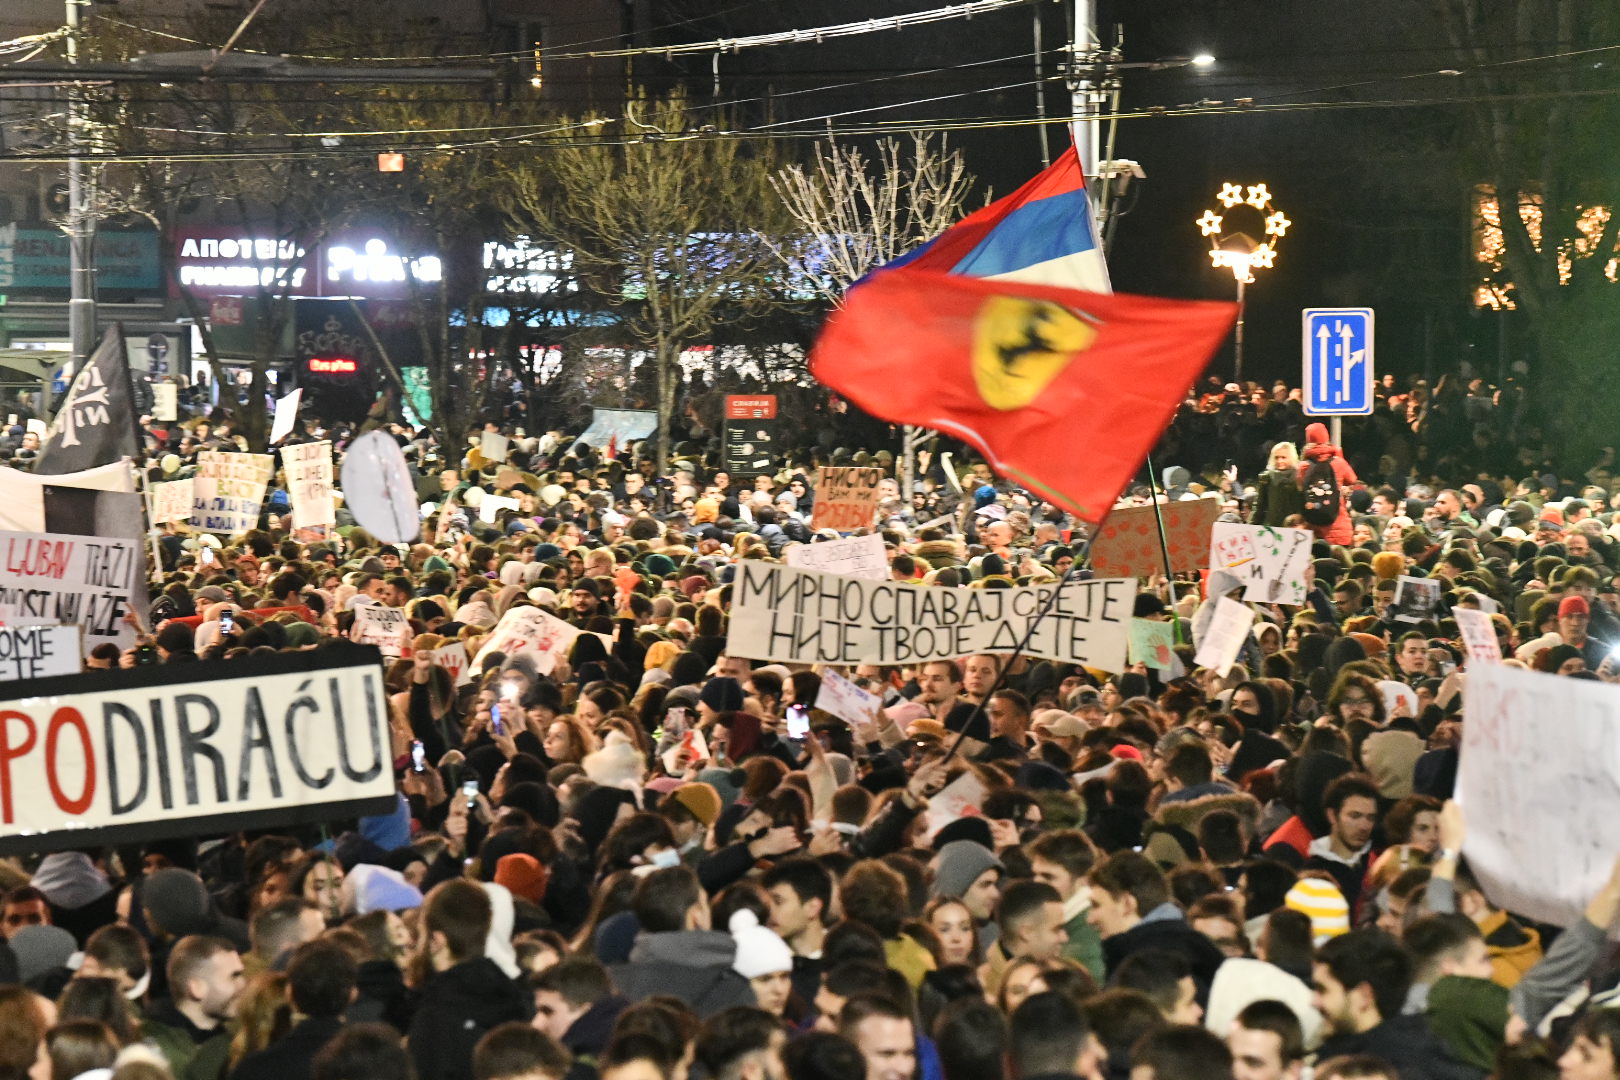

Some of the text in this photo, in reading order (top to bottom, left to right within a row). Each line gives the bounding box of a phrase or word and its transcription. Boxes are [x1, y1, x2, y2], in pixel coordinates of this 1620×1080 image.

[84, 542, 134, 589] TRAŽI
[739, 563, 1126, 625] МИРНО СПАВАЈ СВЕТЕ
[768, 613, 1089, 662] НИЈЕ ТВОЈЕ ДЕТЕ
[0, 673, 384, 824] PODIRAĆU
